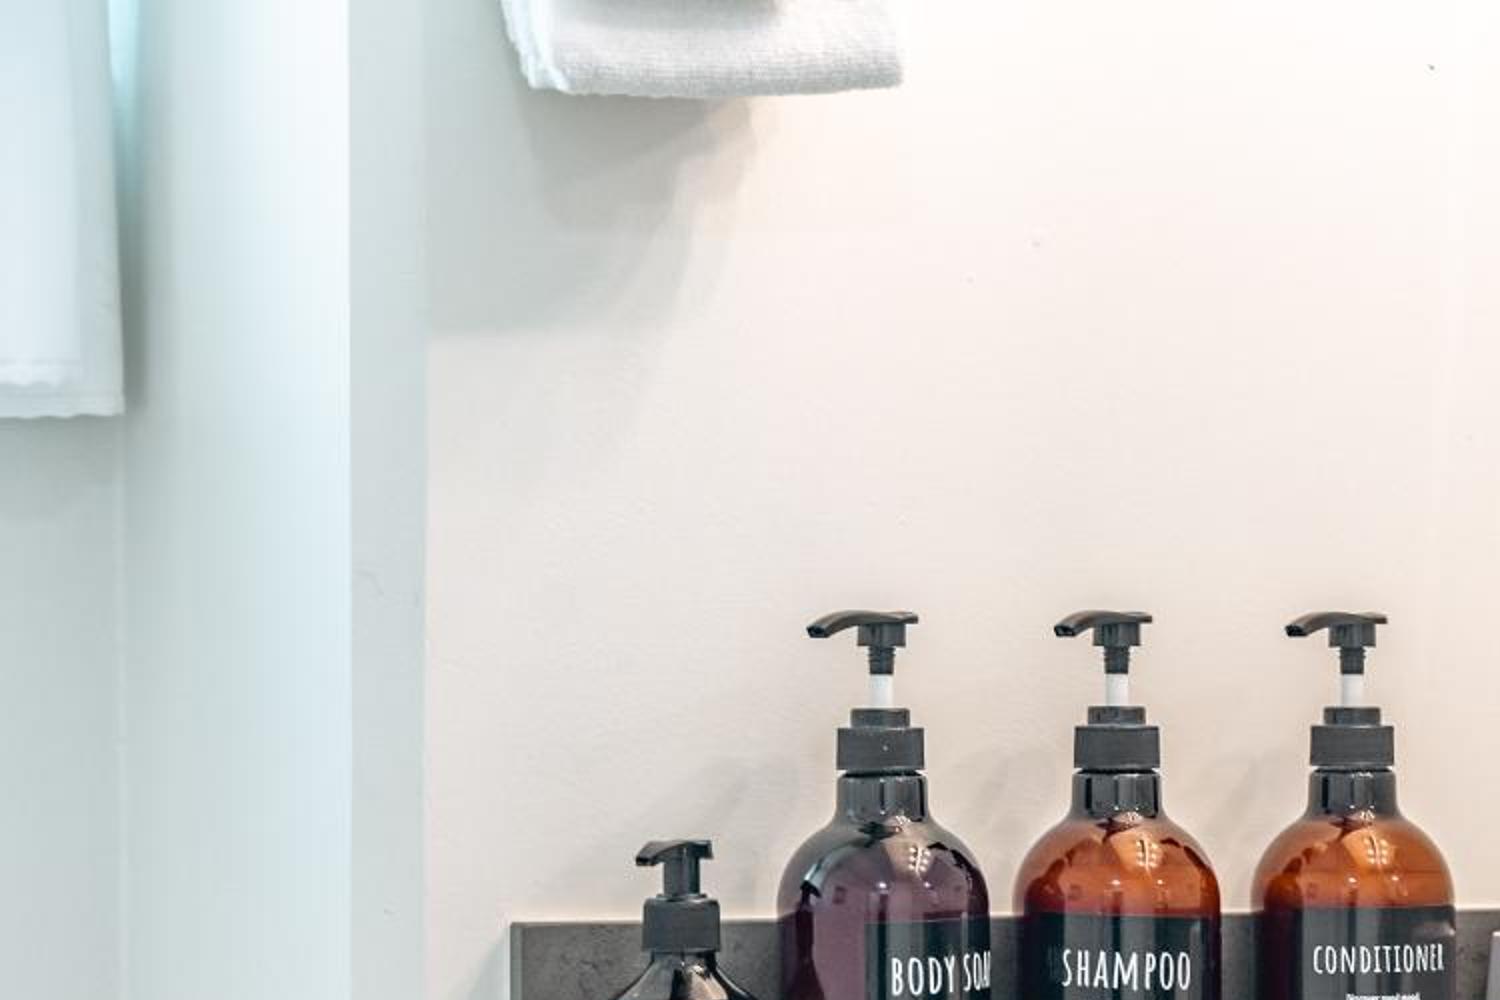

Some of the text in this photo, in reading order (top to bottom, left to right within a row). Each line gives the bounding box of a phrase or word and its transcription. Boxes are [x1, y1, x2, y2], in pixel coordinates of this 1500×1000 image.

[891, 955, 955, 996] BODY
[1062, 948, 1191, 991] SHAMPOO
[1313, 943, 1445, 975] CONDITIONER
